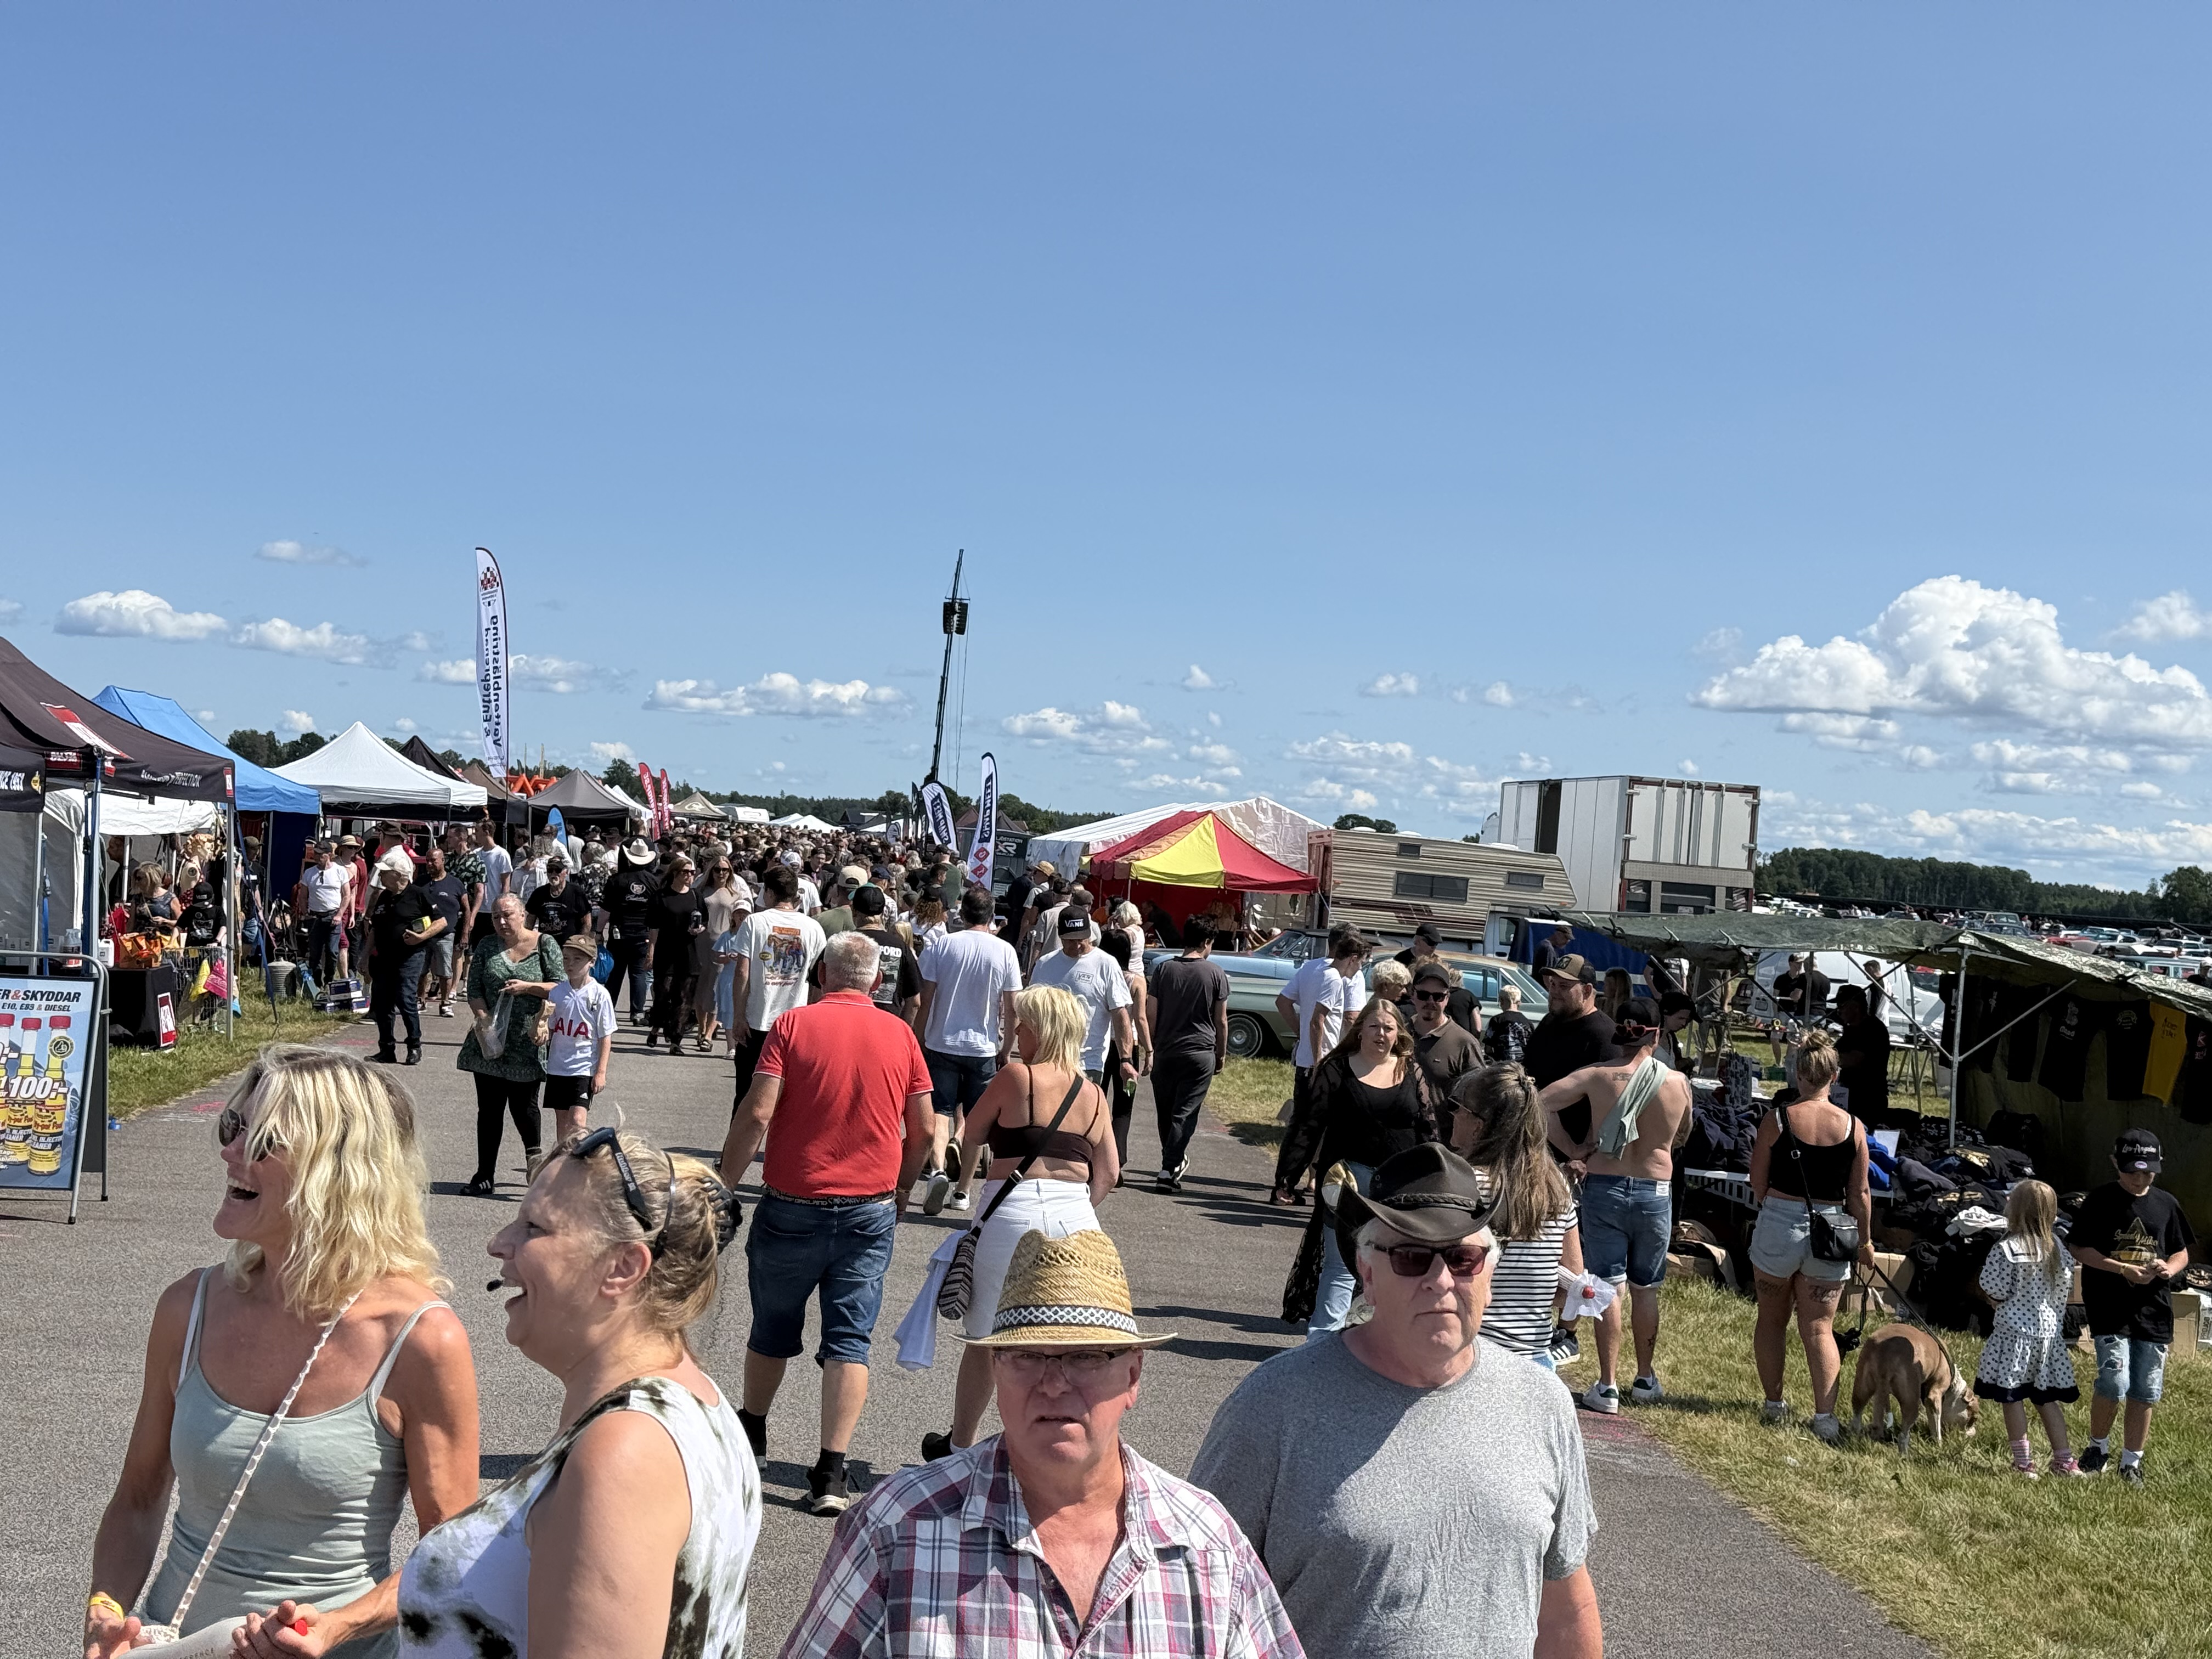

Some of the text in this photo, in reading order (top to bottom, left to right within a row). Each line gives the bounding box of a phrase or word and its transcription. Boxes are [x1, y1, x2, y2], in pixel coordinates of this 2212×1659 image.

[1064, 919, 1084, 928] VANS
[21, 990, 82, 1003] SKYDDAR
[44, 1004, 71, 1012] DIESEL
[554, 1017, 590, 1040] AIA
